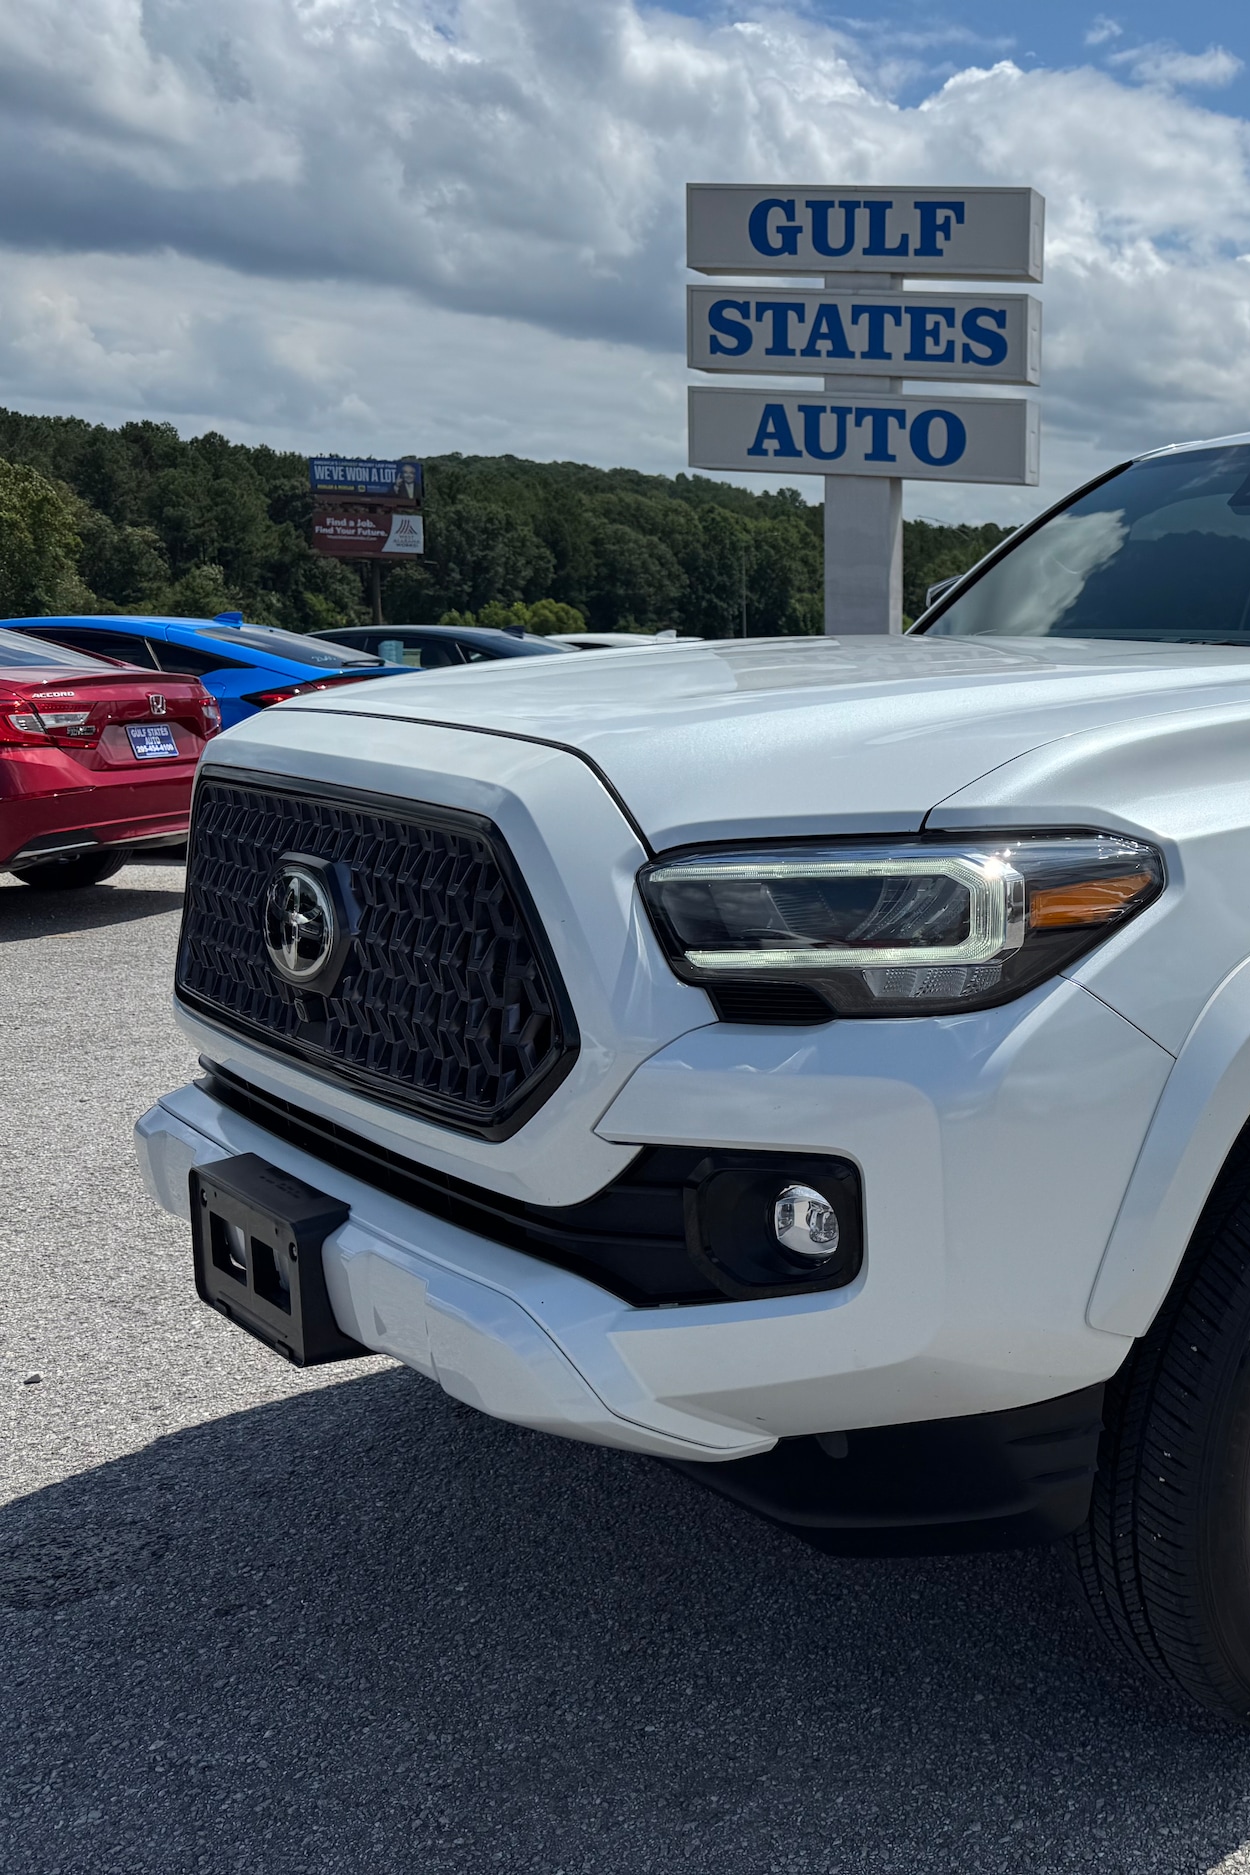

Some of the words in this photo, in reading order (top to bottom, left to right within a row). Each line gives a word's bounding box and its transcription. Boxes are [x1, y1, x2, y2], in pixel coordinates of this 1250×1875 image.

[748, 198, 965, 257] GULF
[708, 300, 1008, 366] STATES
[747, 403, 967, 467] AUTO
[314, 465, 345, 480] WE'VE
[346, 467, 370, 482] WON
[371, 468, 379, 482] A
[380, 469, 397, 483] LOT
[326, 517, 347, 526] Find
[357, 518, 376, 528] Job.
[315, 526, 334, 534] Find
[335, 526, 356, 535] Your
[32, 691, 75, 699] ACCORD
[131, 728, 147, 738] GULF
[147, 727, 169, 737] STATES
[145, 736, 162, 745] AUTO
